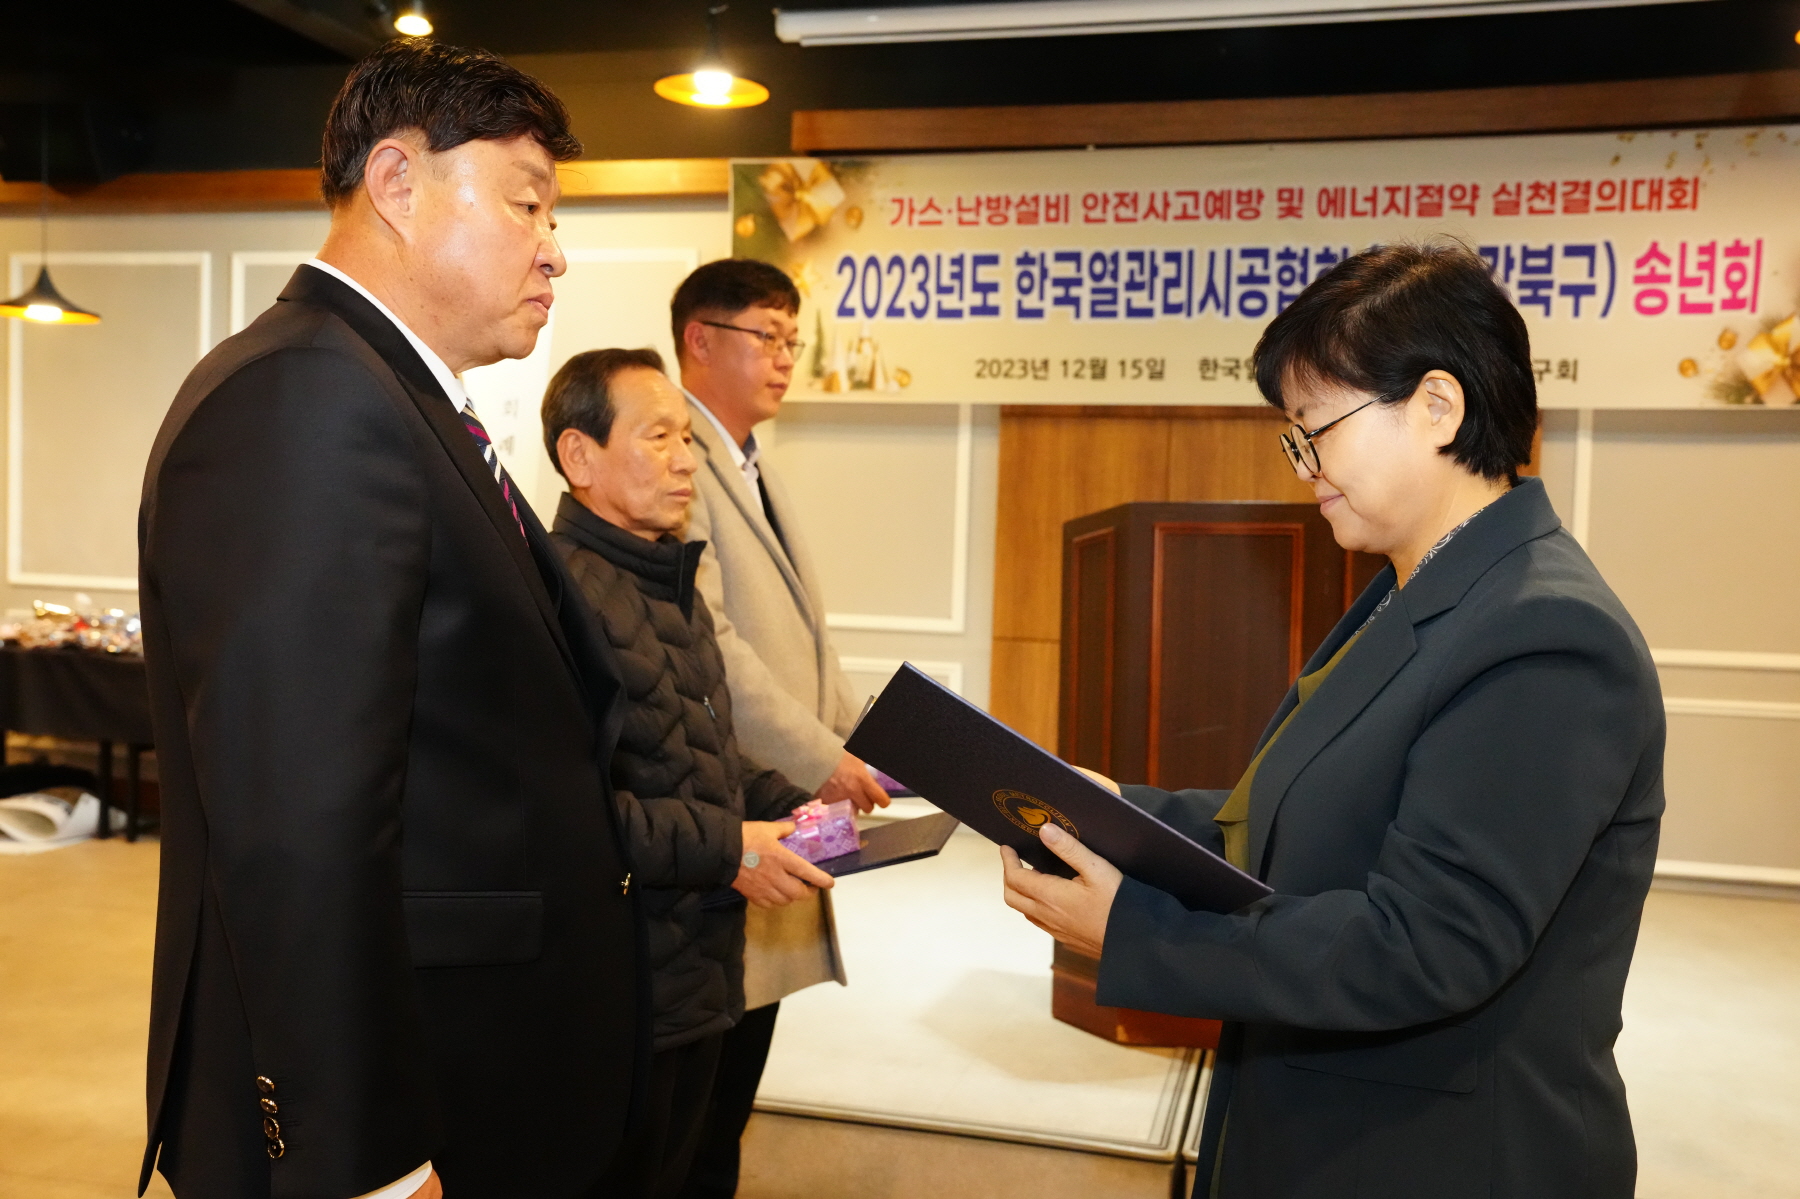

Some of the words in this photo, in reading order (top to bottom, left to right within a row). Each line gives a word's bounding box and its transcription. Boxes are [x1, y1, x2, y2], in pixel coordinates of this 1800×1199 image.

[1082, 187, 1266, 224] 안전사고예방
[1277, 187, 1305, 220] 및
[1317, 183, 1481, 219] 에너지절약
[1492, 176, 1700, 216] 실천결의대회
[836, 252, 1001, 320] 2023년도
[1633, 238, 1763, 316] 송년회
[975, 357, 1050, 381] 2023년
[1061, 356, 1108, 381] 12월
[1119, 356, 1167, 381] 15일
